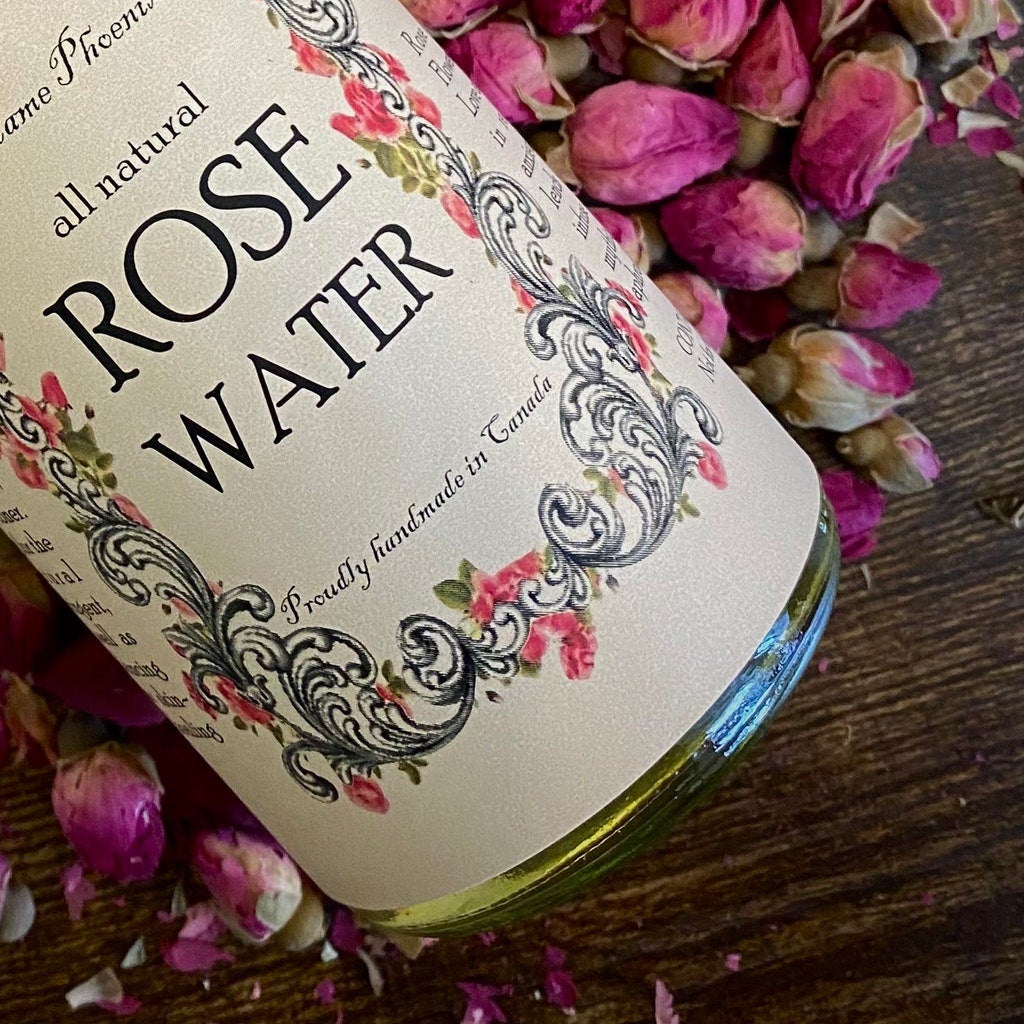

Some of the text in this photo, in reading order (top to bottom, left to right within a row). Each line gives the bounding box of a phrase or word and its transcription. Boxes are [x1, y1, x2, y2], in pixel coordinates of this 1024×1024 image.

[53, 81, 209, 239] all natural
[489, 128, 507, 148] in
[42, 103, 352, 394] ROSE
[140, 223, 454, 494] WATER
[22, 528, 55, 554] the
[280, 373, 553, 625] Proudly handmade in Canada
[117, 630, 138, 647] as
